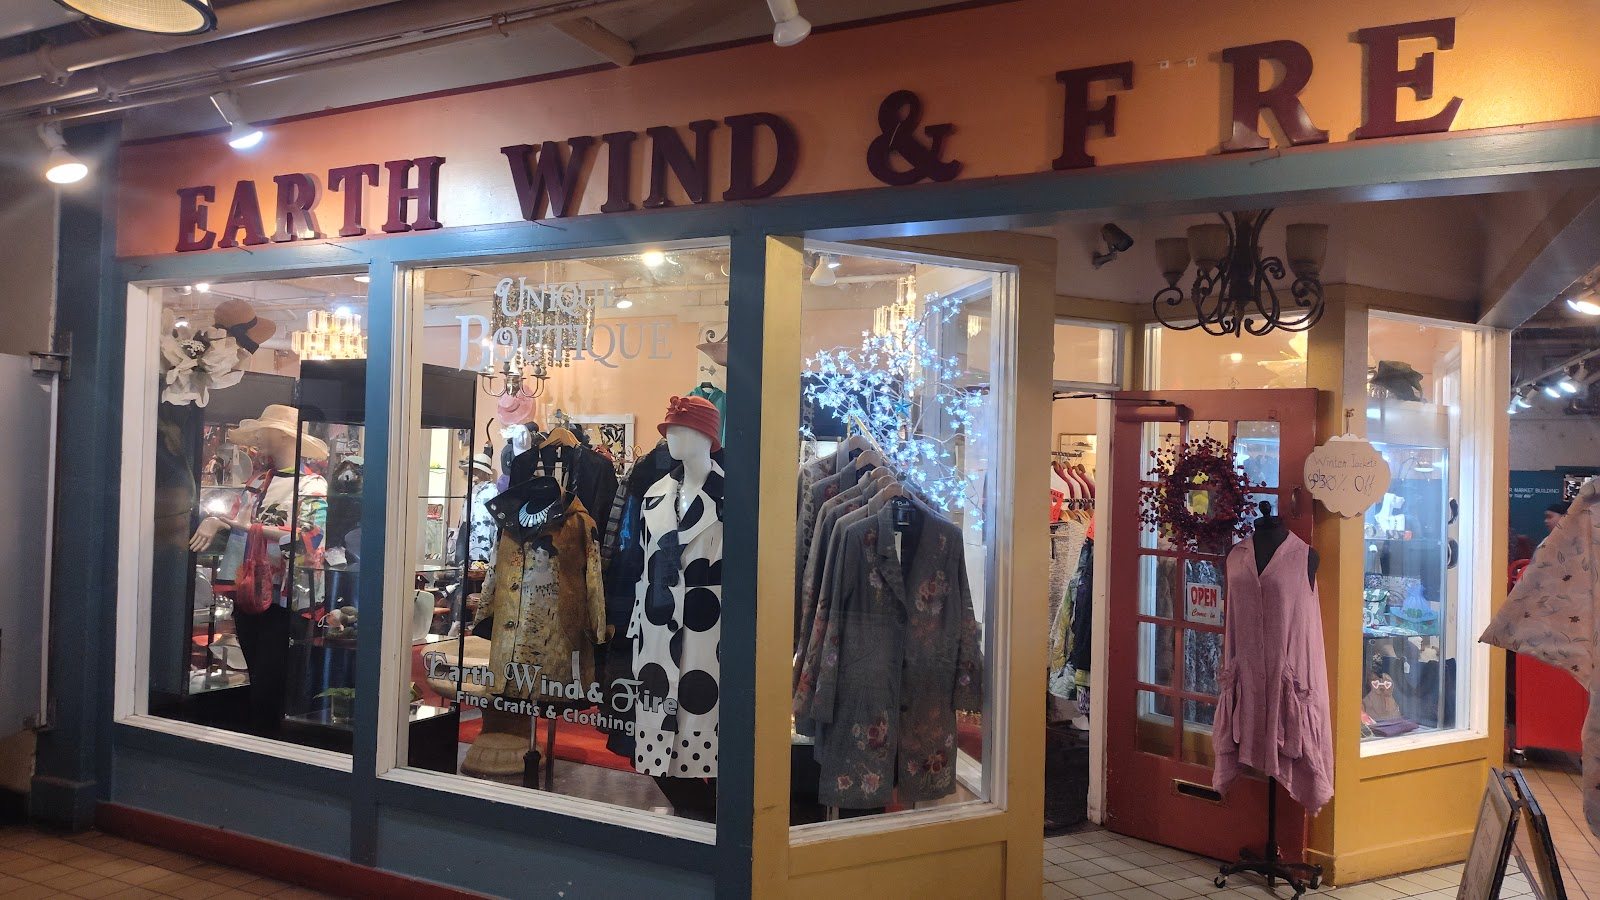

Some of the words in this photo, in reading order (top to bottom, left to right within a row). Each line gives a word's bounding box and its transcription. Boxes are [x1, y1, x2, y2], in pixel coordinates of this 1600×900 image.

[175, 156, 446, 252] EARTH
[500, 112, 799, 221] WIND
[866, 89, 964, 187] &
[1191, 586, 1217, 608] OPEN
[1192, 608, 1207, 618] Come
[423, 650, 495, 687] Earth
[503, 660, 584, 699] Wind
[586, 682, 604, 704] &
[611, 677, 679, 716] Fire
[456, 690, 488, 709] Fine
[493, 696, 540, 717] Crafts
[545, 705, 557, 720] &
[563, 708, 635, 737] Clothing
